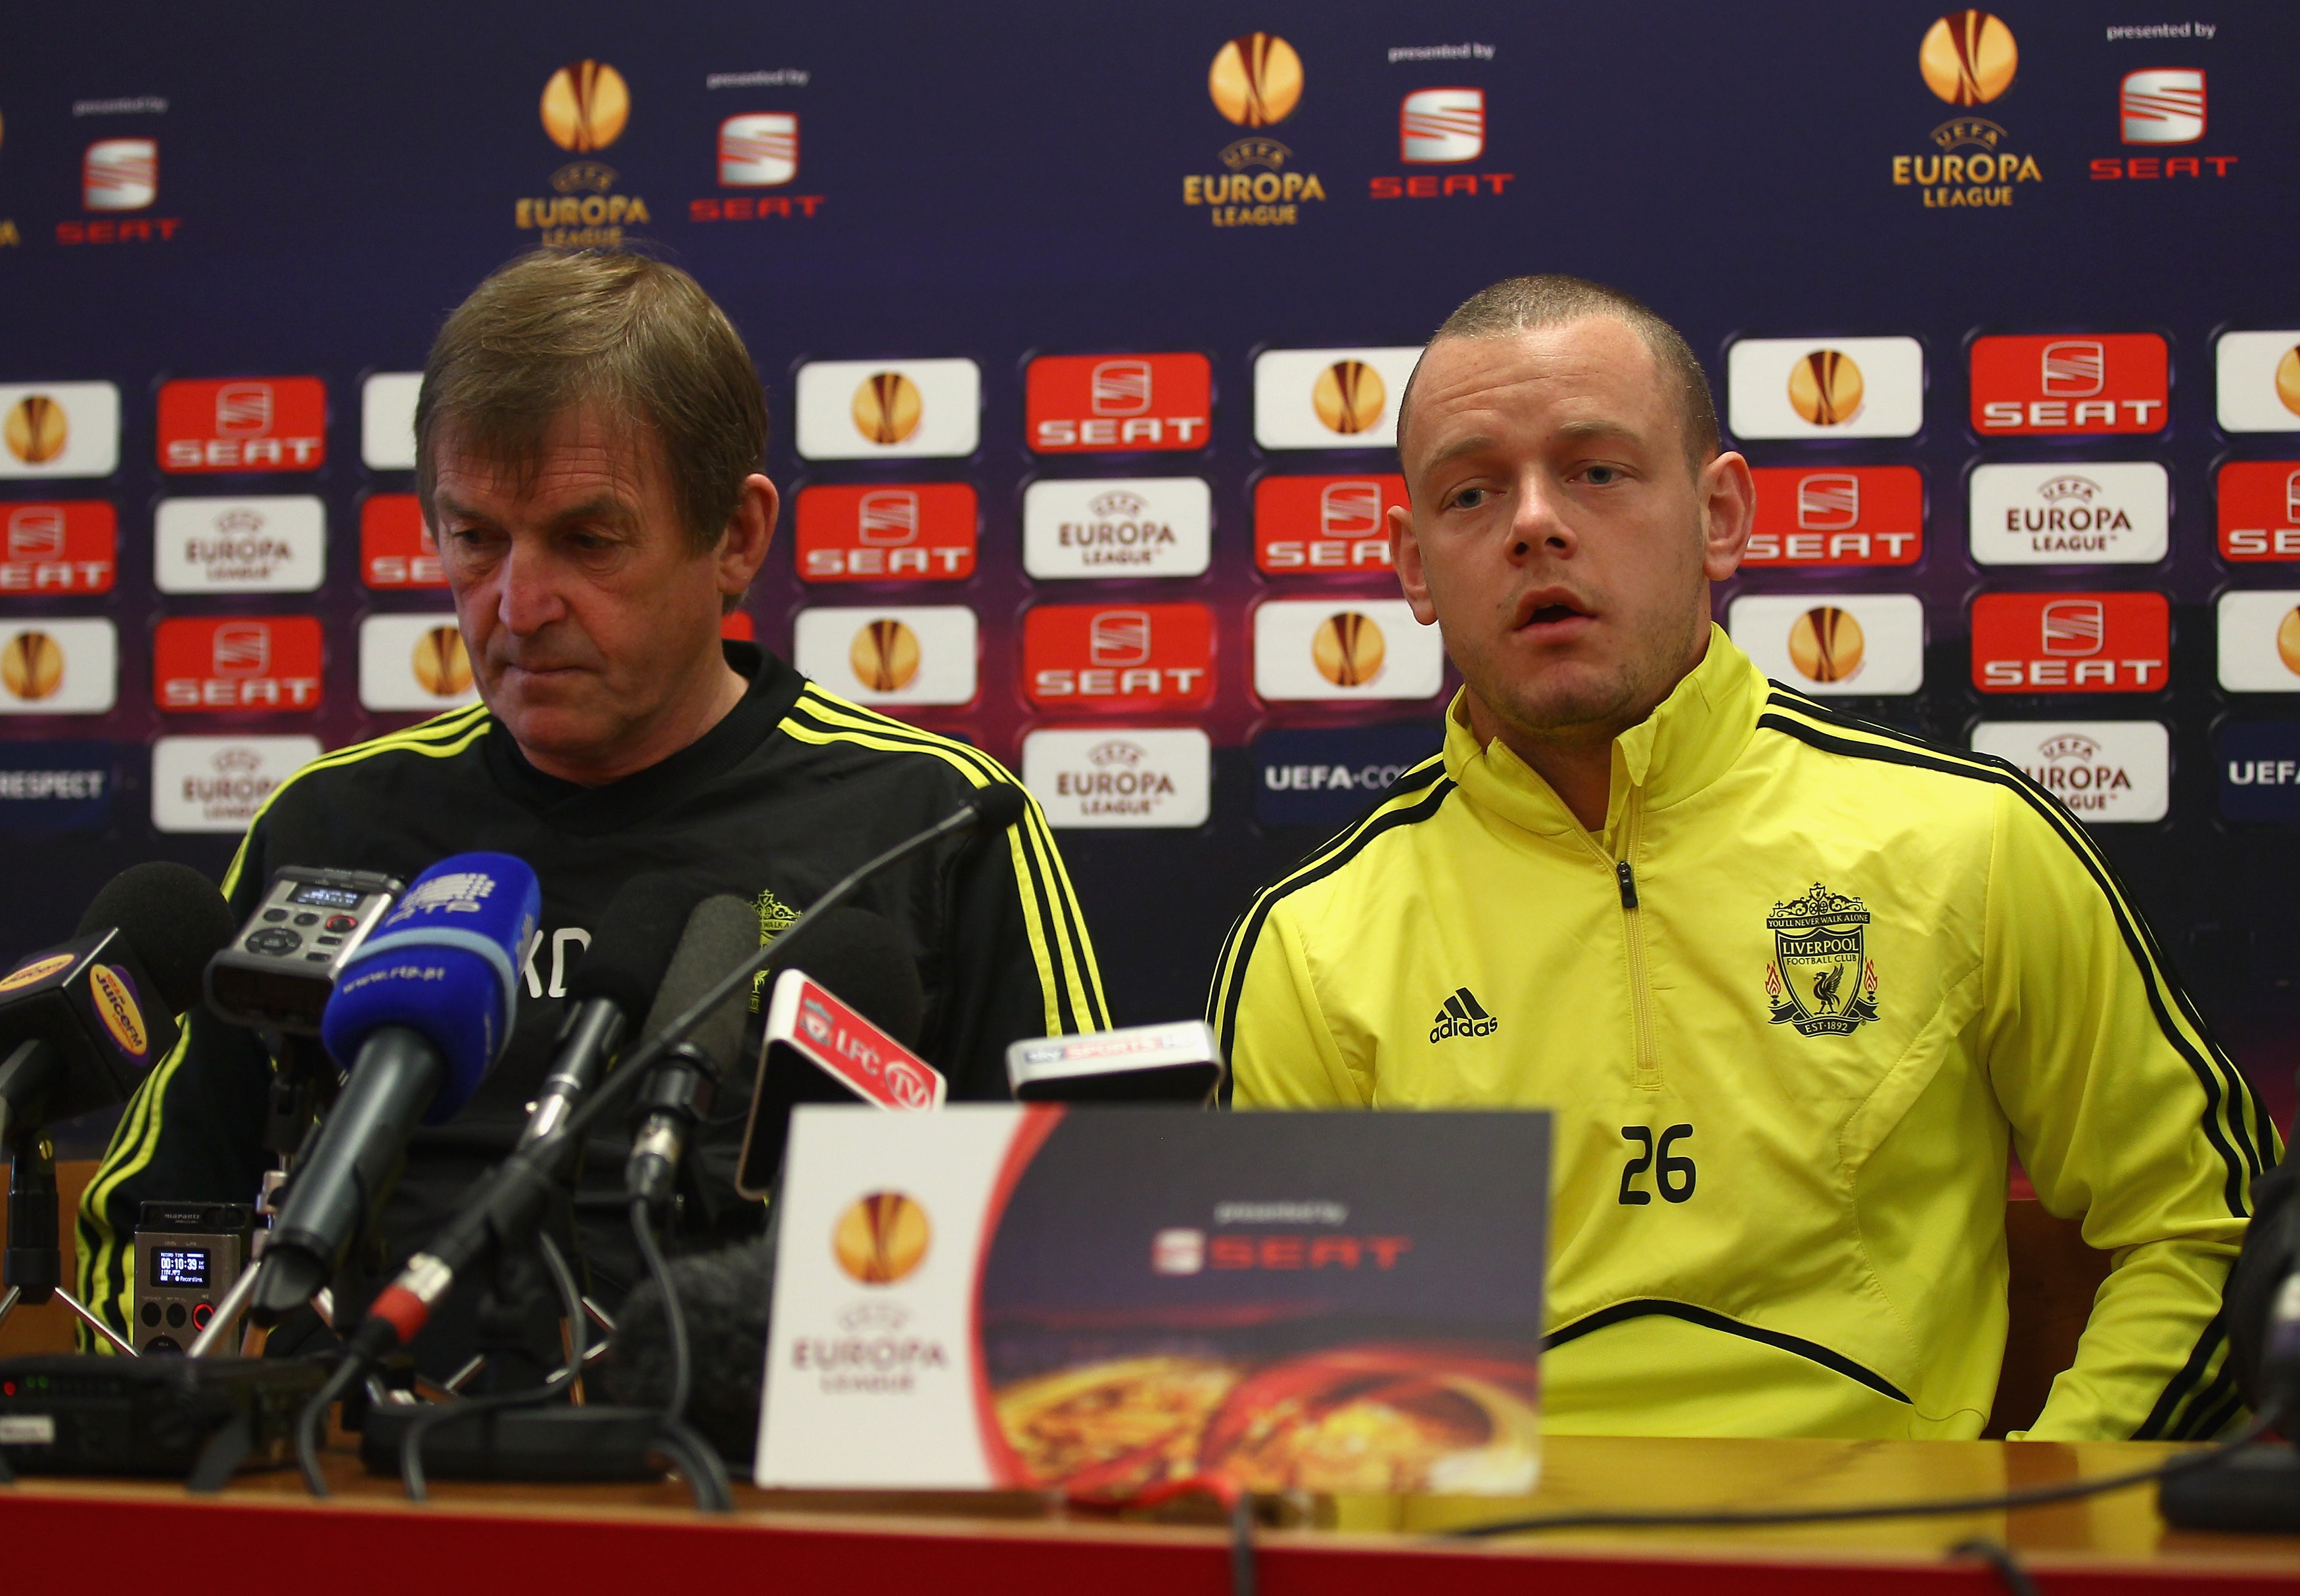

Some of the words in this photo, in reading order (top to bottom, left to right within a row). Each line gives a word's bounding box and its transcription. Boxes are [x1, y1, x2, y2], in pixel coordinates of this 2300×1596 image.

[2106, 23, 2191, 41] presented
[2194, 21, 2217, 39] by
[1388, 43, 1468, 64] presented
[1471, 41, 1495, 61] by
[789, 67, 810, 87] by
[1935, 125, 1999, 148] UEFA
[1893, 153, 2042, 186] EUROPA
[2089, 156, 2238, 180] SEAT
[1184, 172, 1326, 206] EUROPA
[1369, 173, 1515, 200] SEAT
[1923, 186, 2013, 207] LEAGUE
[515, 195, 651, 229] EUROPA
[689, 195, 826, 222] SEAT
[1212, 205, 1298, 227] LEAGUE
[55, 218, 182, 244] SEAT
[1983, 399, 2162, 428] SEAT
[1036, 417, 1204, 446] SEAT
[167, 436, 321, 467] SEAT
[2041, 479, 2096, 501] UEFA
[2006, 507, 2132, 532] EUROPA
[1059, 522, 1177, 547] EUROPA
[1743, 532, 1916, 560] SEAT
[2033, 536, 2107, 554] LEAGUE
[2228, 529, 2300, 555] SE
[185, 540, 293, 565] EUROPA
[806, 546, 971, 576] SEAT
[1082, 549, 1152, 566] LEAGUE
[1266, 540, 1391, 567] SEA
[0, 560, 111, 589] EAT
[370, 556, 449, 583] SE
[1035, 669, 1203, 696] SEAT
[1984, 659, 2163, 687] SEAT
[164, 677, 319, 706] SEAT
[2042, 739, 2094, 760] UEFA
[1057, 771, 1175, 797] EUROPA
[2025, 765, 2132, 790] UROPA
[2228, 760, 2300, 787] UEF
[183, 775, 283, 802] EUROP
[1081, 799, 1151, 817] LEAGUE
[1796, 917, 1819, 926] NEVER
[1820, 916, 1843, 924] WALK
[1844, 914, 1869, 923] ALONE
[1782, 938, 1859, 955] LIVERPOOL
[1786, 957, 1832, 966] FOOTBALL
[1429, 1016, 1498, 1044] adidas
[836, 1028, 881, 1077] LFC
[894, 1069, 927, 1105] TV
[1617, 1123, 1697, 1205] 26
[160, 1258, 197, 1271] 00:10:39
[1207, 1236, 1412, 1270] SEAT
[793, 1336, 949, 1372] EUROPA
